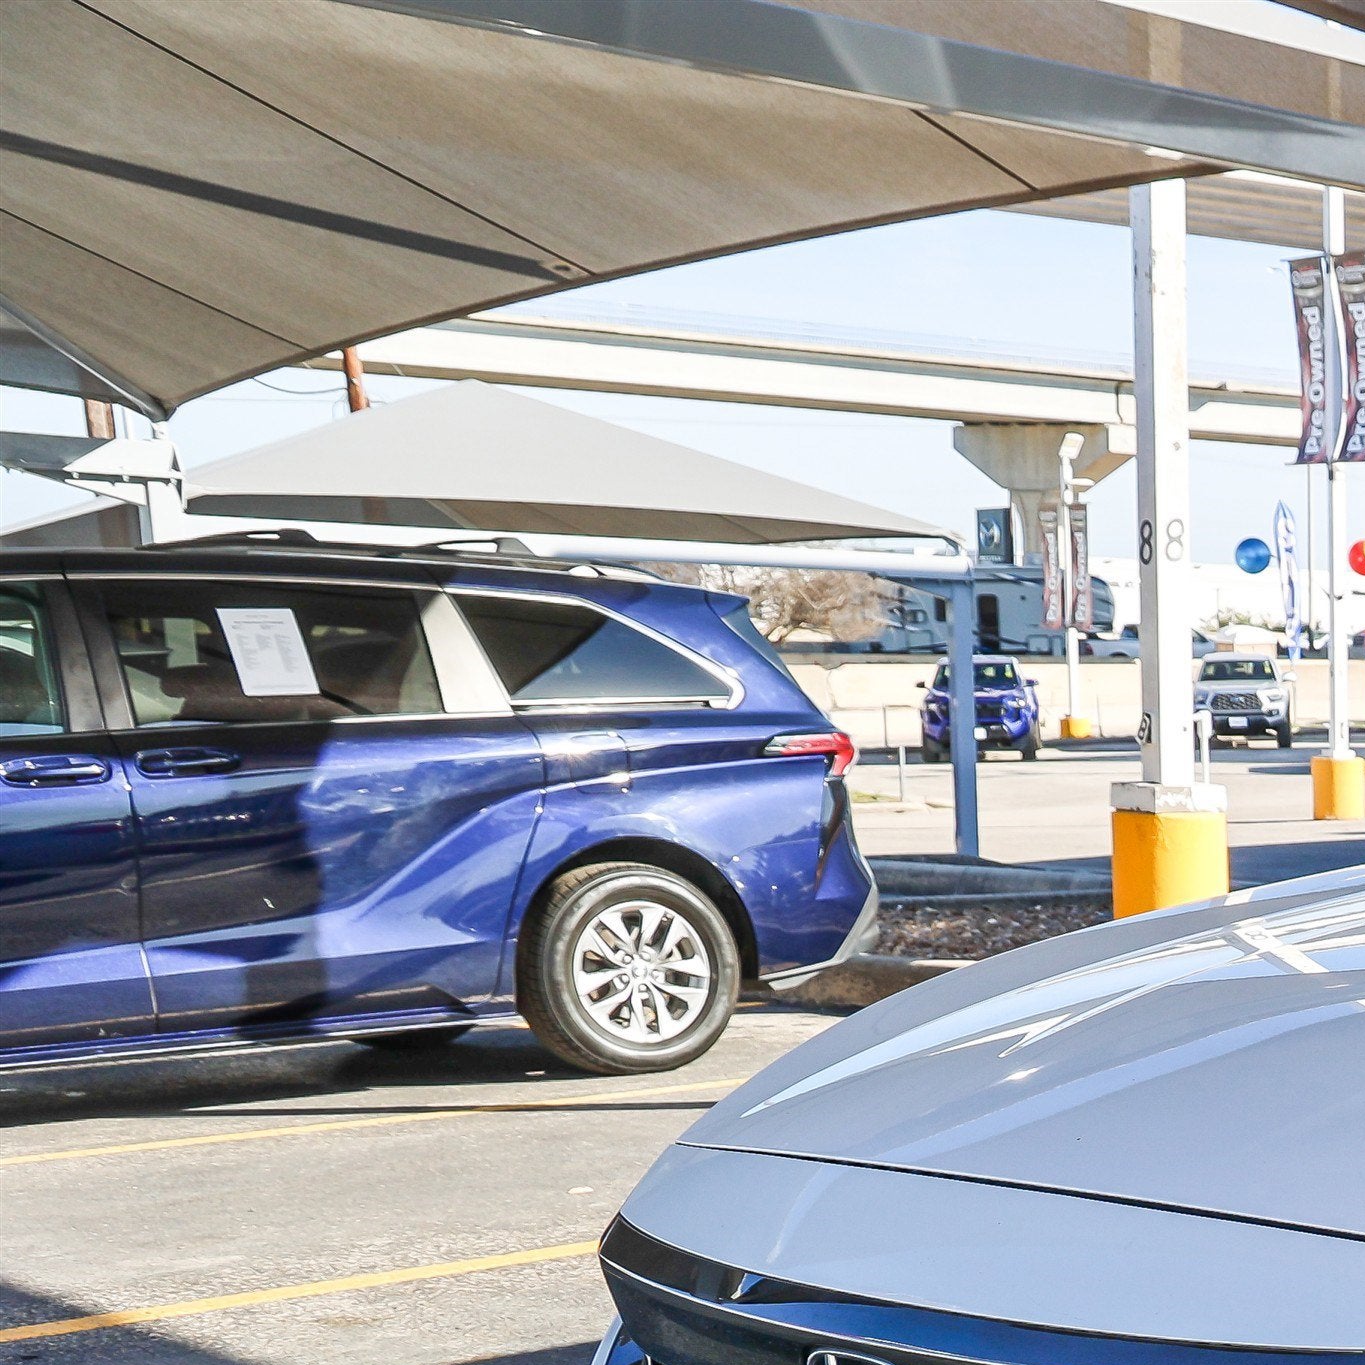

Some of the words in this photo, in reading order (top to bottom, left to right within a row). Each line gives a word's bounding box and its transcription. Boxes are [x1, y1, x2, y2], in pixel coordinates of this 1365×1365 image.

[1301, 305, 1325, 403] Owned
[1304, 408, 1324, 455] Pre
[1140, 519, 1153, 565] 8
